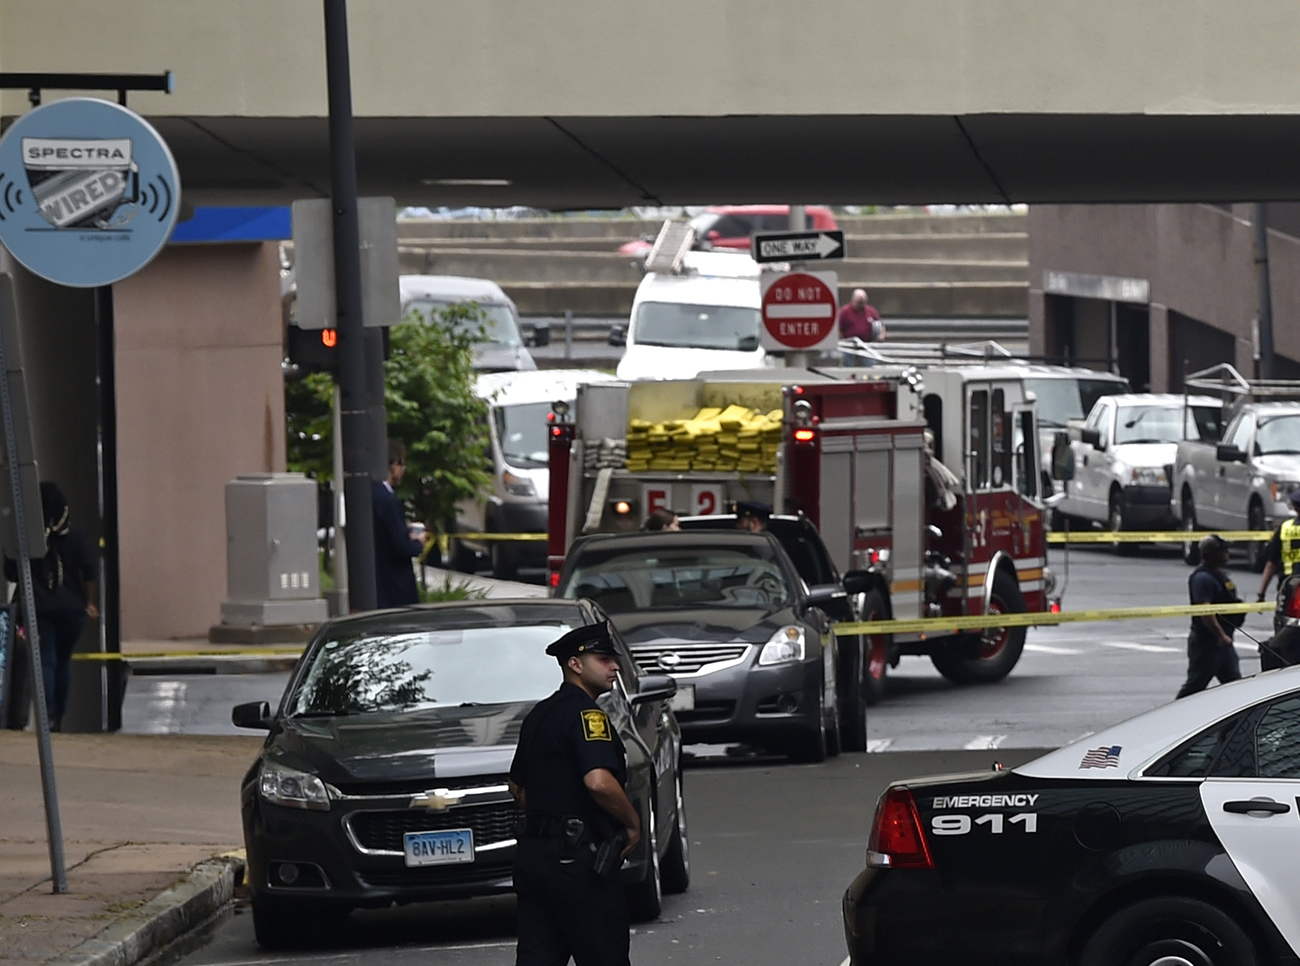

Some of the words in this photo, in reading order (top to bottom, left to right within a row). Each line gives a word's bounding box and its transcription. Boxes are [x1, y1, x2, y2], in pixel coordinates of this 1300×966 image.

[28, 147, 124, 159] SPECTRA
[44, 171, 121, 220] WIRED
[763, 241, 789, 254] ONE
[793, 241, 816, 252] WAY
[775, 287, 793, 301] DO
[798, 287, 821, 300] NOT
[779, 322, 819, 335] ENTER
[698, 490, 716, 515] 2
[932, 794, 1039, 809] EMERGENCY
[931, 812, 1037, 836] 911
